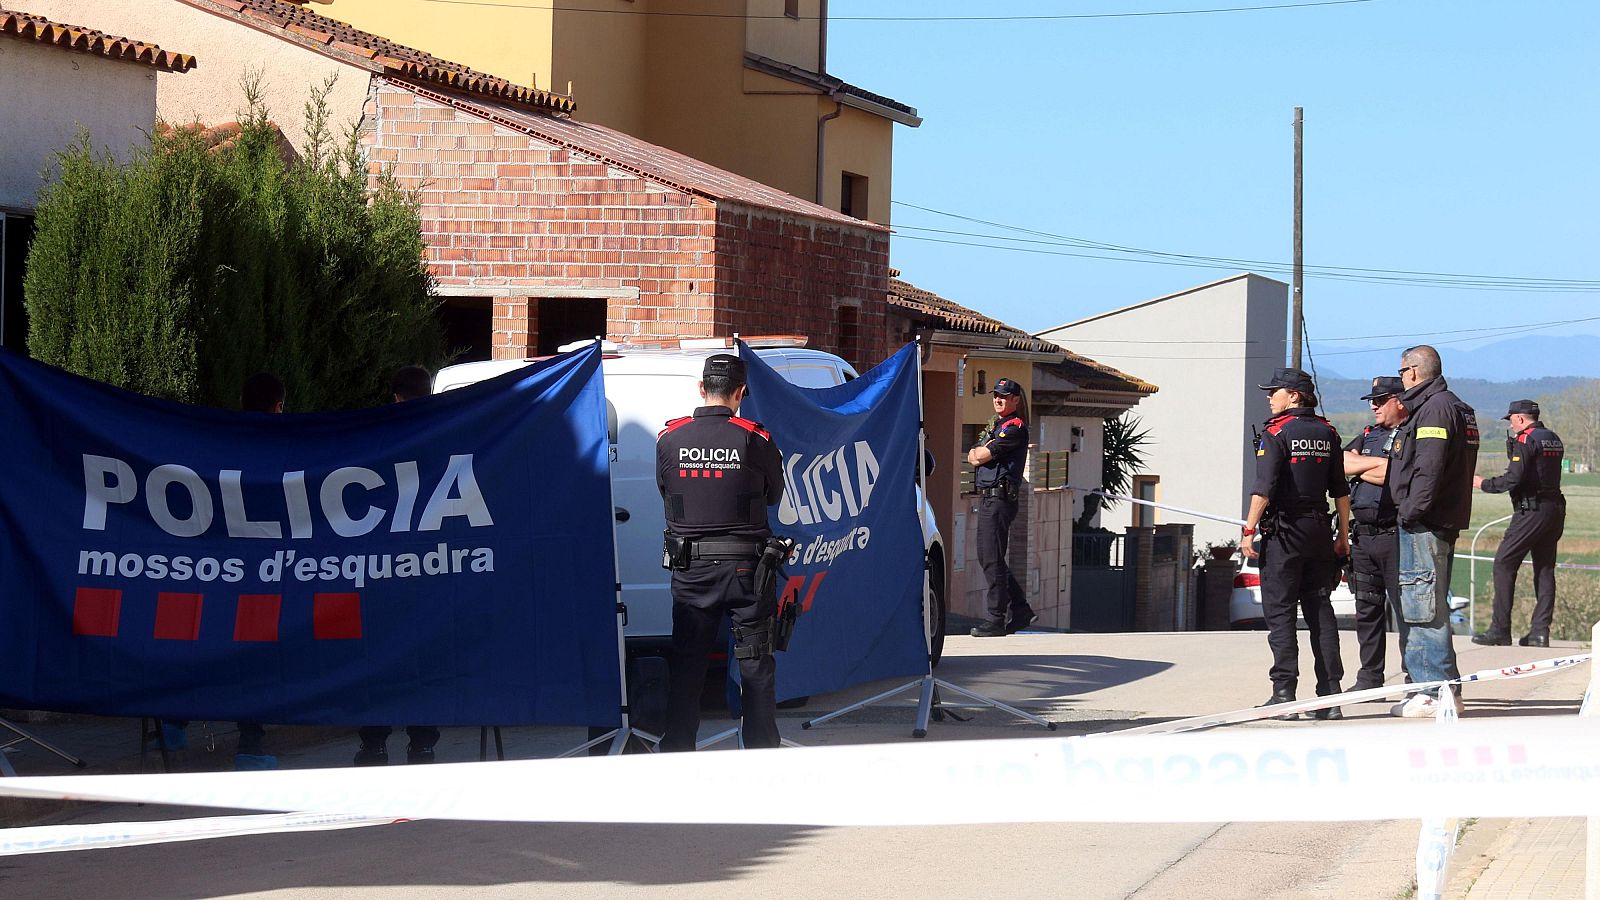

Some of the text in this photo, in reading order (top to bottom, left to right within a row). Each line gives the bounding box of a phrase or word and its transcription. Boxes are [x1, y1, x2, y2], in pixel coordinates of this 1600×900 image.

[679, 447, 741, 462] POLICIA
[1291, 439, 1331, 451] POLICIA
[705, 461, 741, 470] d'esquadra
[82, 453, 495, 539] POLICIA
[777, 440, 881, 526] OLICIA
[78, 543, 495, 587] mossos d'esquadra
